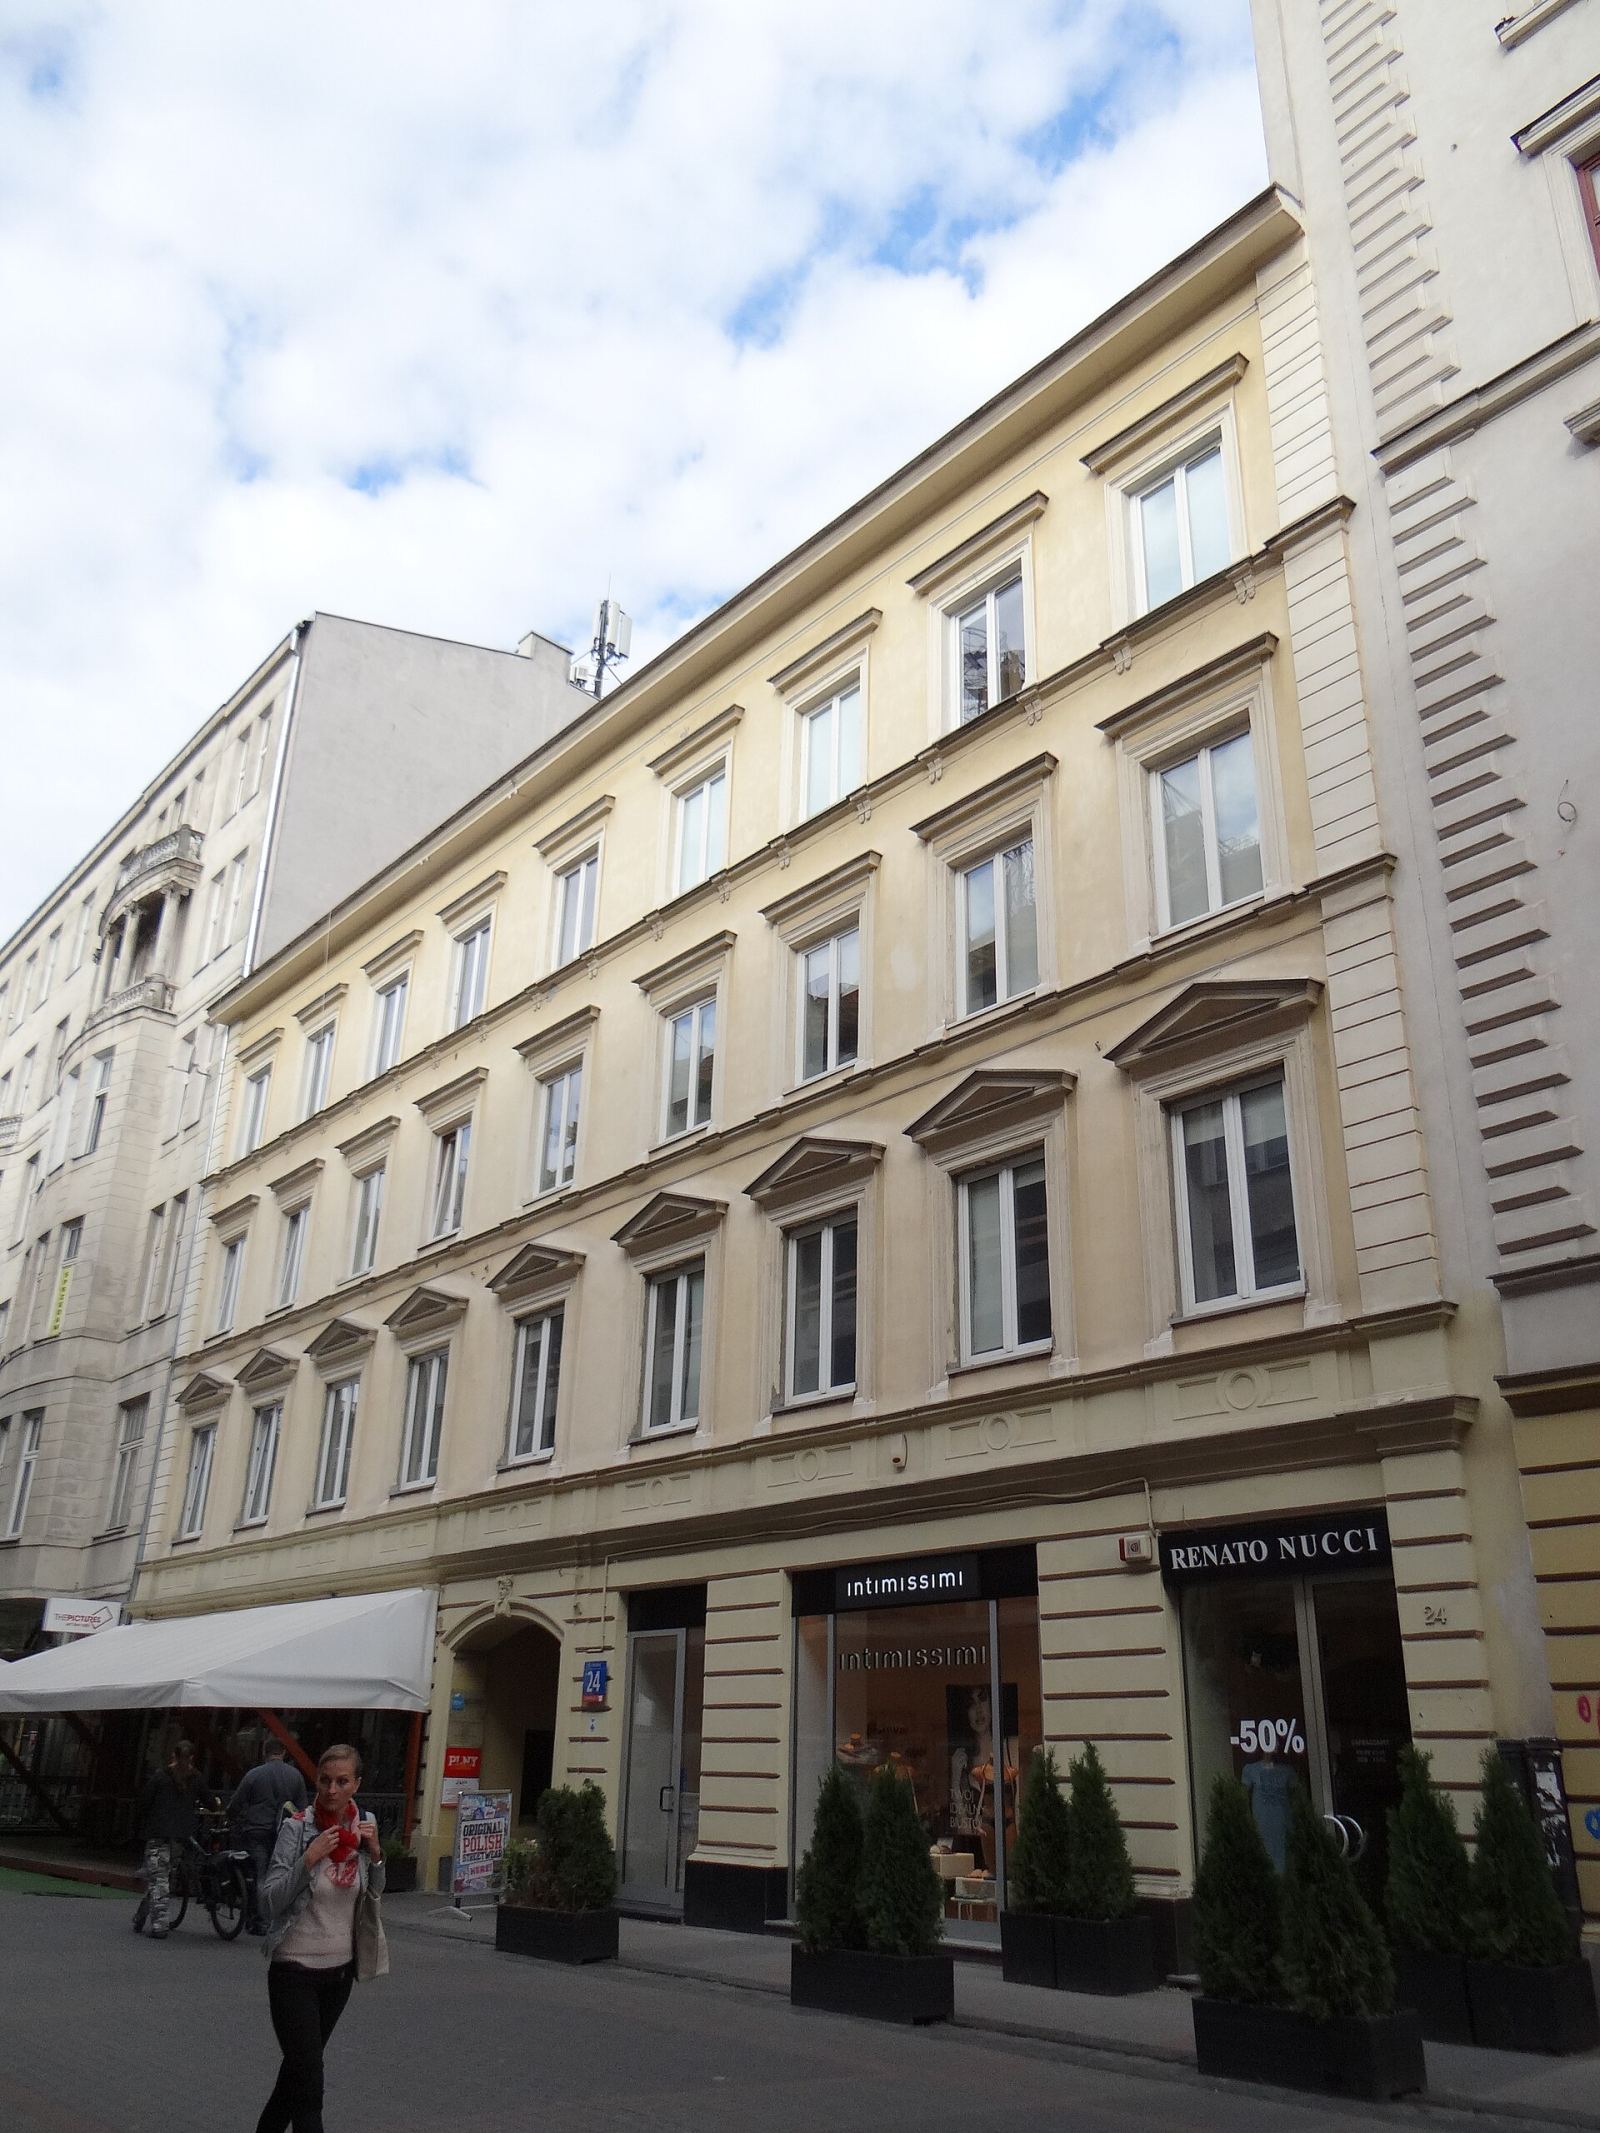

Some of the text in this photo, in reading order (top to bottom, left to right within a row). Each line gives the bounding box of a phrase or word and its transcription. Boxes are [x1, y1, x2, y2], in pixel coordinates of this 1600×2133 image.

[1171, 1527, 1377, 1570] RENATO NUCCI
[847, 1570, 963, 1597] intimissimi
[1424, 1606, 1447, 1625] 24
[840, 1646, 986, 1671] intimissimi
[586, 1670, 600, 1693] 24
[1230, 1718, 1305, 1754] -50%
[463, 1821, 503, 1837] ORIGINAL
[463, 1834, 502, 1854] POLISH
